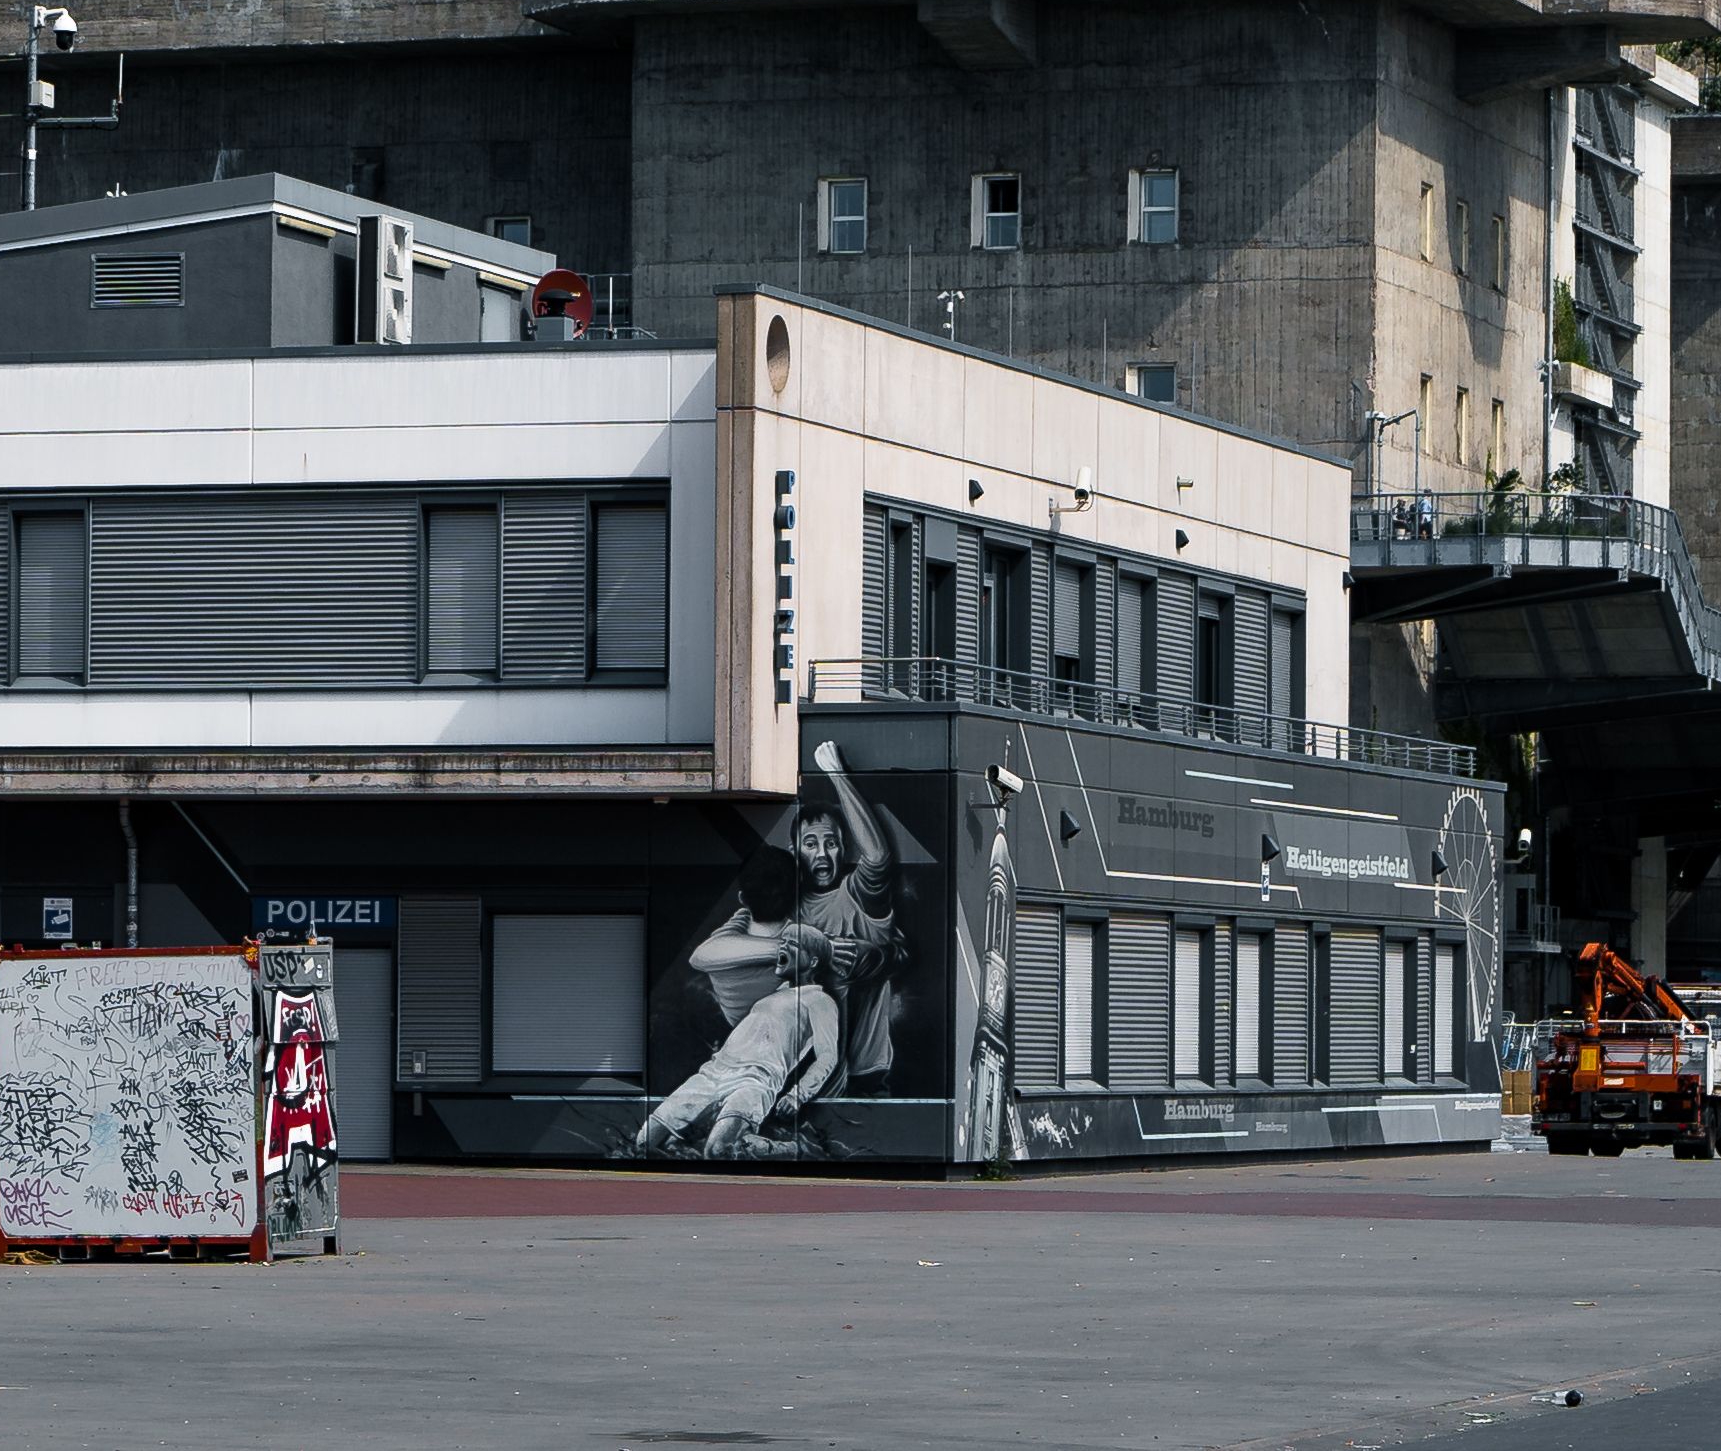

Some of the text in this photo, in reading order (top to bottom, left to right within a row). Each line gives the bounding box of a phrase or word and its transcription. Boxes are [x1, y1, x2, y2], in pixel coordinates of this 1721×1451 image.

[774, 469, 796, 704] POLIZEI
[1116, 798, 1215, 838] Hamburg
[1286, 845, 1410, 879] Heiligengeistfeld
[266, 900, 381, 924] POLIZEI
[1164, 1099, 1234, 1122] Hamburg
